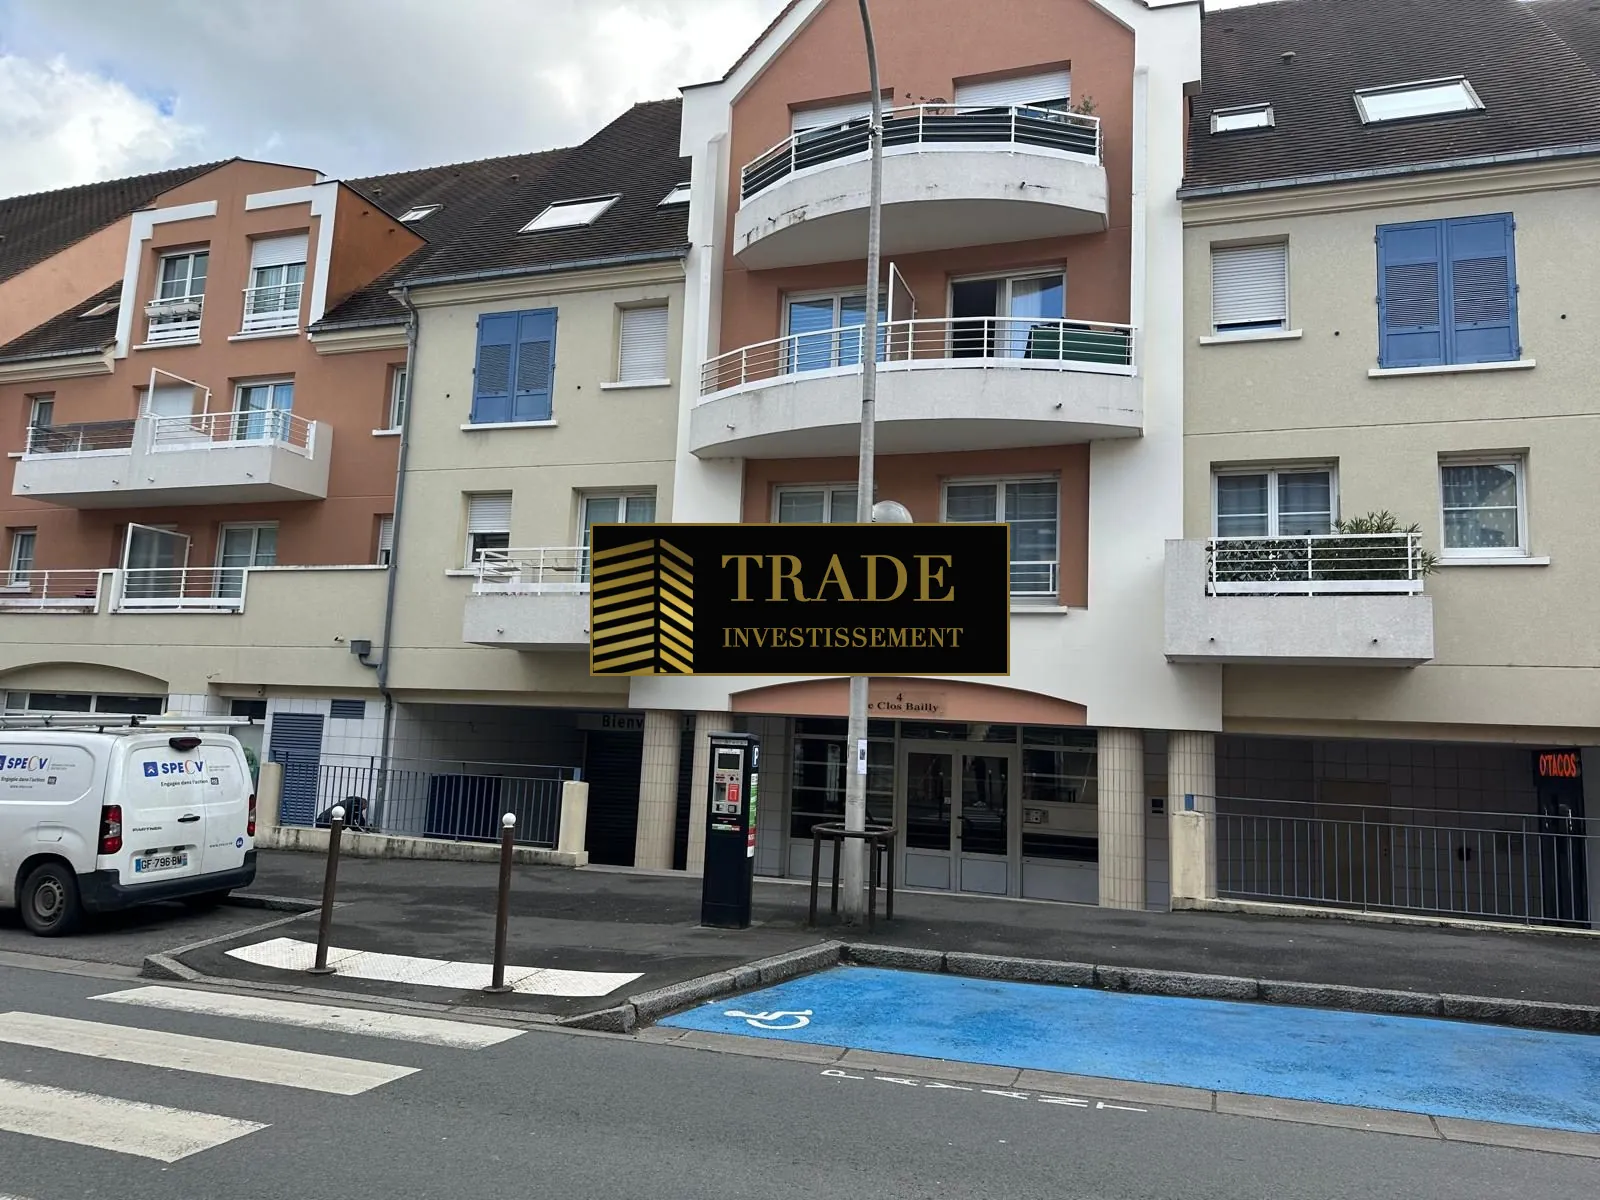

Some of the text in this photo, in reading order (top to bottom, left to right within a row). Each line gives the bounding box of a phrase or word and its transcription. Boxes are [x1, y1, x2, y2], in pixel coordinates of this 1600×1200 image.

[896, 693, 903, 702] 4
[877, 702, 902, 710] Clos
[906, 703, 940, 713] Bailly
[602, 714, 644, 729] Bienv
[820, 1069, 1148, 1113] PAYANT
